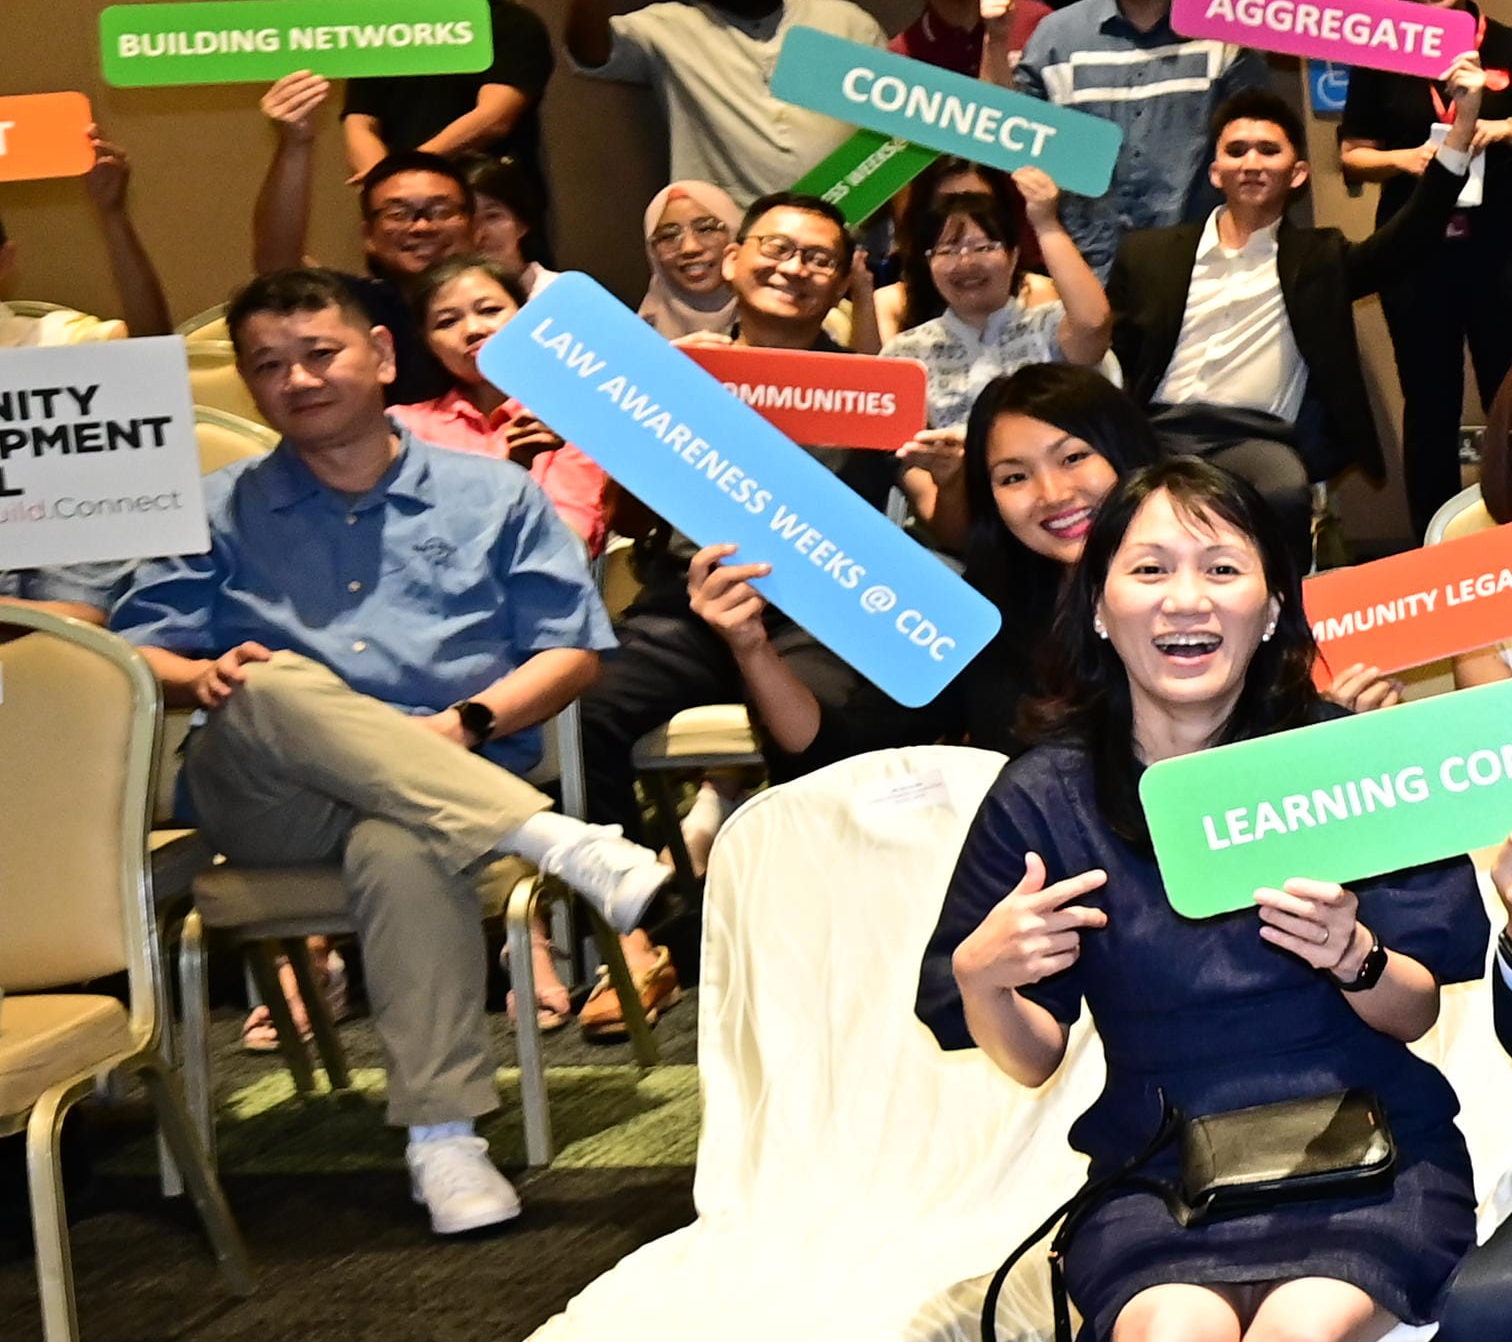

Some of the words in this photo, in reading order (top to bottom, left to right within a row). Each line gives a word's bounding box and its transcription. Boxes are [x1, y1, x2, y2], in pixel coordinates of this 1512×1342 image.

[118, 27, 280, 59] BUILDING
[289, 21, 474, 51] NETWORKS
[842, 66, 1057, 159] CONNECT
[530, 318, 605, 378] LAW
[597, 373, 773, 515] AWARENESS
[769, 502, 866, 590] WEEKS
[861, 584, 897, 615] @
[896, 608, 957, 662] CDC
[1202, 766, 1430, 850] LEARNING
